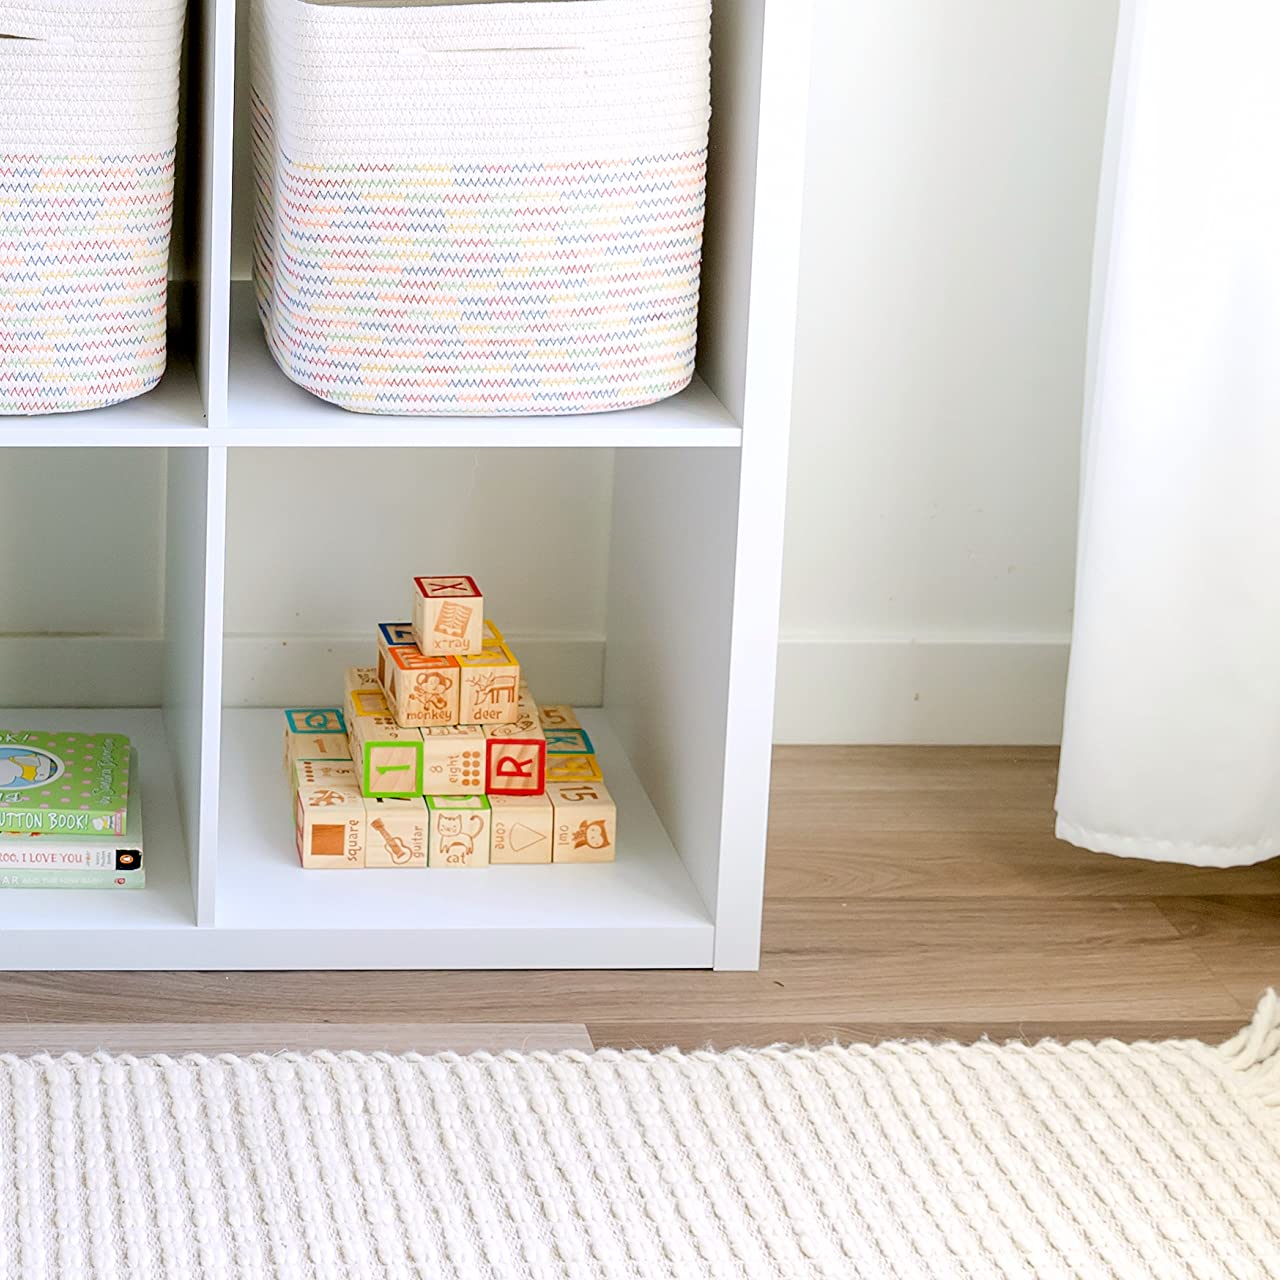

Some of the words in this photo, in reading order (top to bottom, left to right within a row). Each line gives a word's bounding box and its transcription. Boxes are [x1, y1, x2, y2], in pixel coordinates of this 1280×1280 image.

[428, 582, 468, 592] X
[434, 638, 470, 651] x-ray
[304, 712, 329, 730] Q
[406, 709, 452, 722] monkey
[473, 708, 504, 720] deer
[430, 765, 443, 773] 8
[447, 754, 461, 783] eight
[496, 756, 533, 778] R
[559, 785, 599, 802] 15
[48, 812, 89, 830] BOOK!
[347, 819, 362, 862] square
[411, 825, 424, 858] guitar
[494, 823, 506, 850] cone
[558, 825, 570, 846] owl
[22, 853, 29, 863] I
[29, 852, 57, 863] LOVE
[59, 853, 82, 864] YOU
[446, 852, 466, 865] cat
